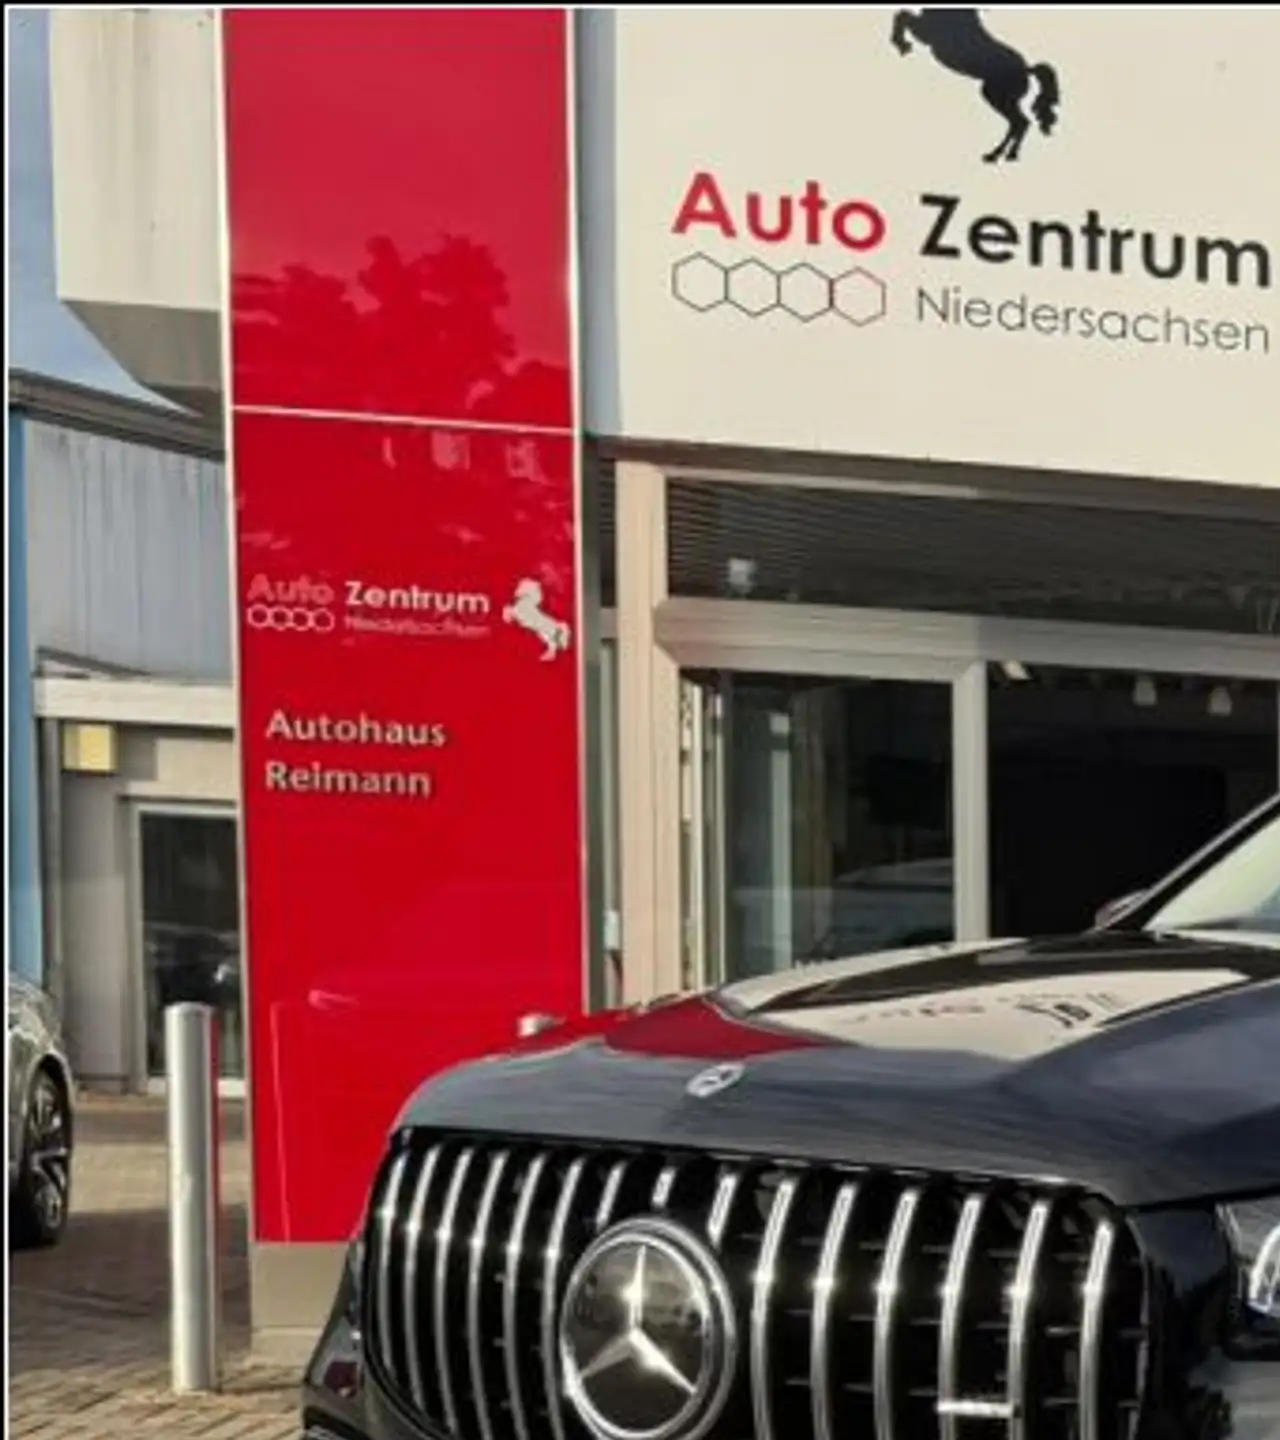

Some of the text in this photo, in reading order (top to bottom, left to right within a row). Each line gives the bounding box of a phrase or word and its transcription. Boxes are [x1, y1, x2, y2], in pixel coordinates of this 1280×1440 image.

[672, 171, 1272, 289] Auto Zentrum
[916, 286, 1271, 354] Niedersachsen
[247, 573, 491, 614] Auto Zentrum
[265, 708, 448, 747] Autohaus
[264, 759, 431, 798] Reimann
